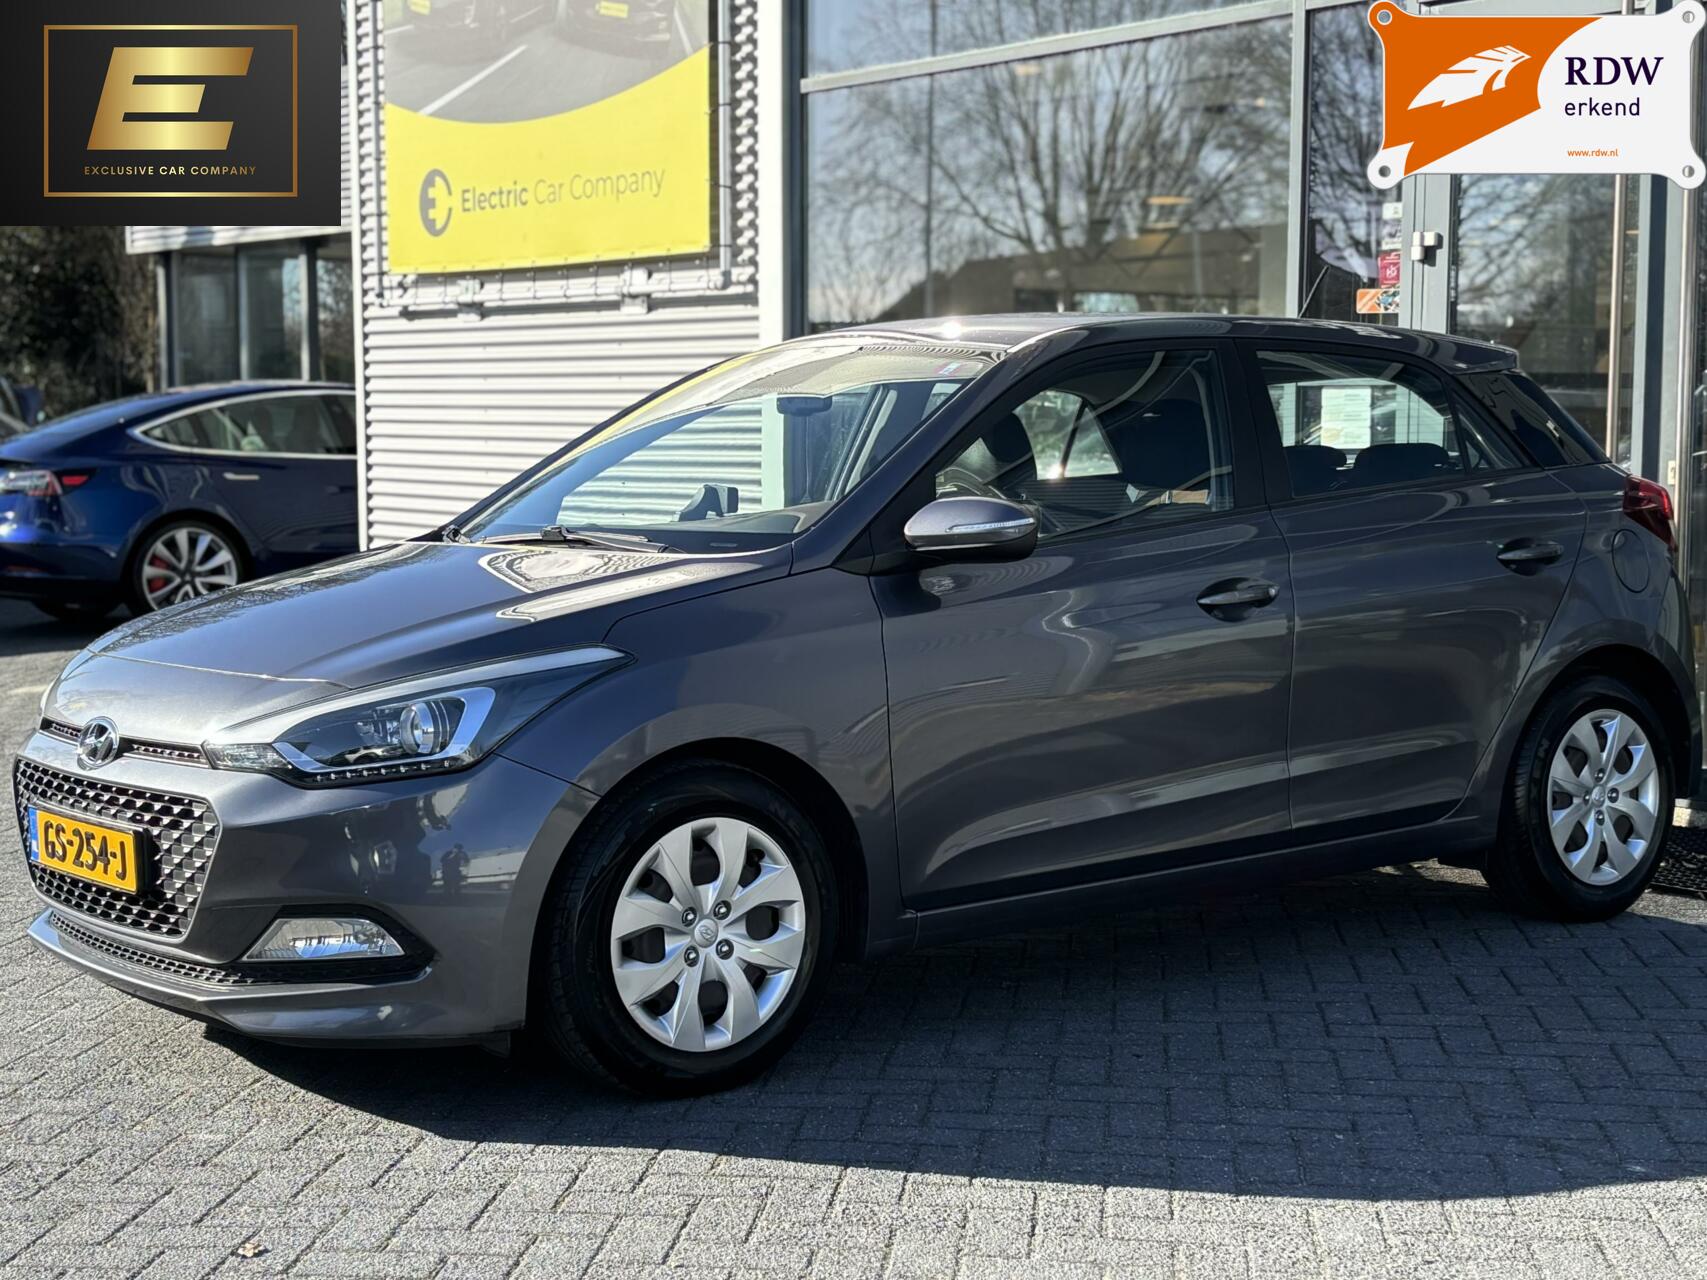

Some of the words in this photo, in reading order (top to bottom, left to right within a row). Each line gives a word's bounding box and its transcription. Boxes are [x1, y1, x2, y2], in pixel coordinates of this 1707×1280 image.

[461, 180, 529, 212] Electric
[534, 179, 564, 205] Car
[569, 168, 666, 202] Company
[44, 820, 127, 881] GS-254-J
